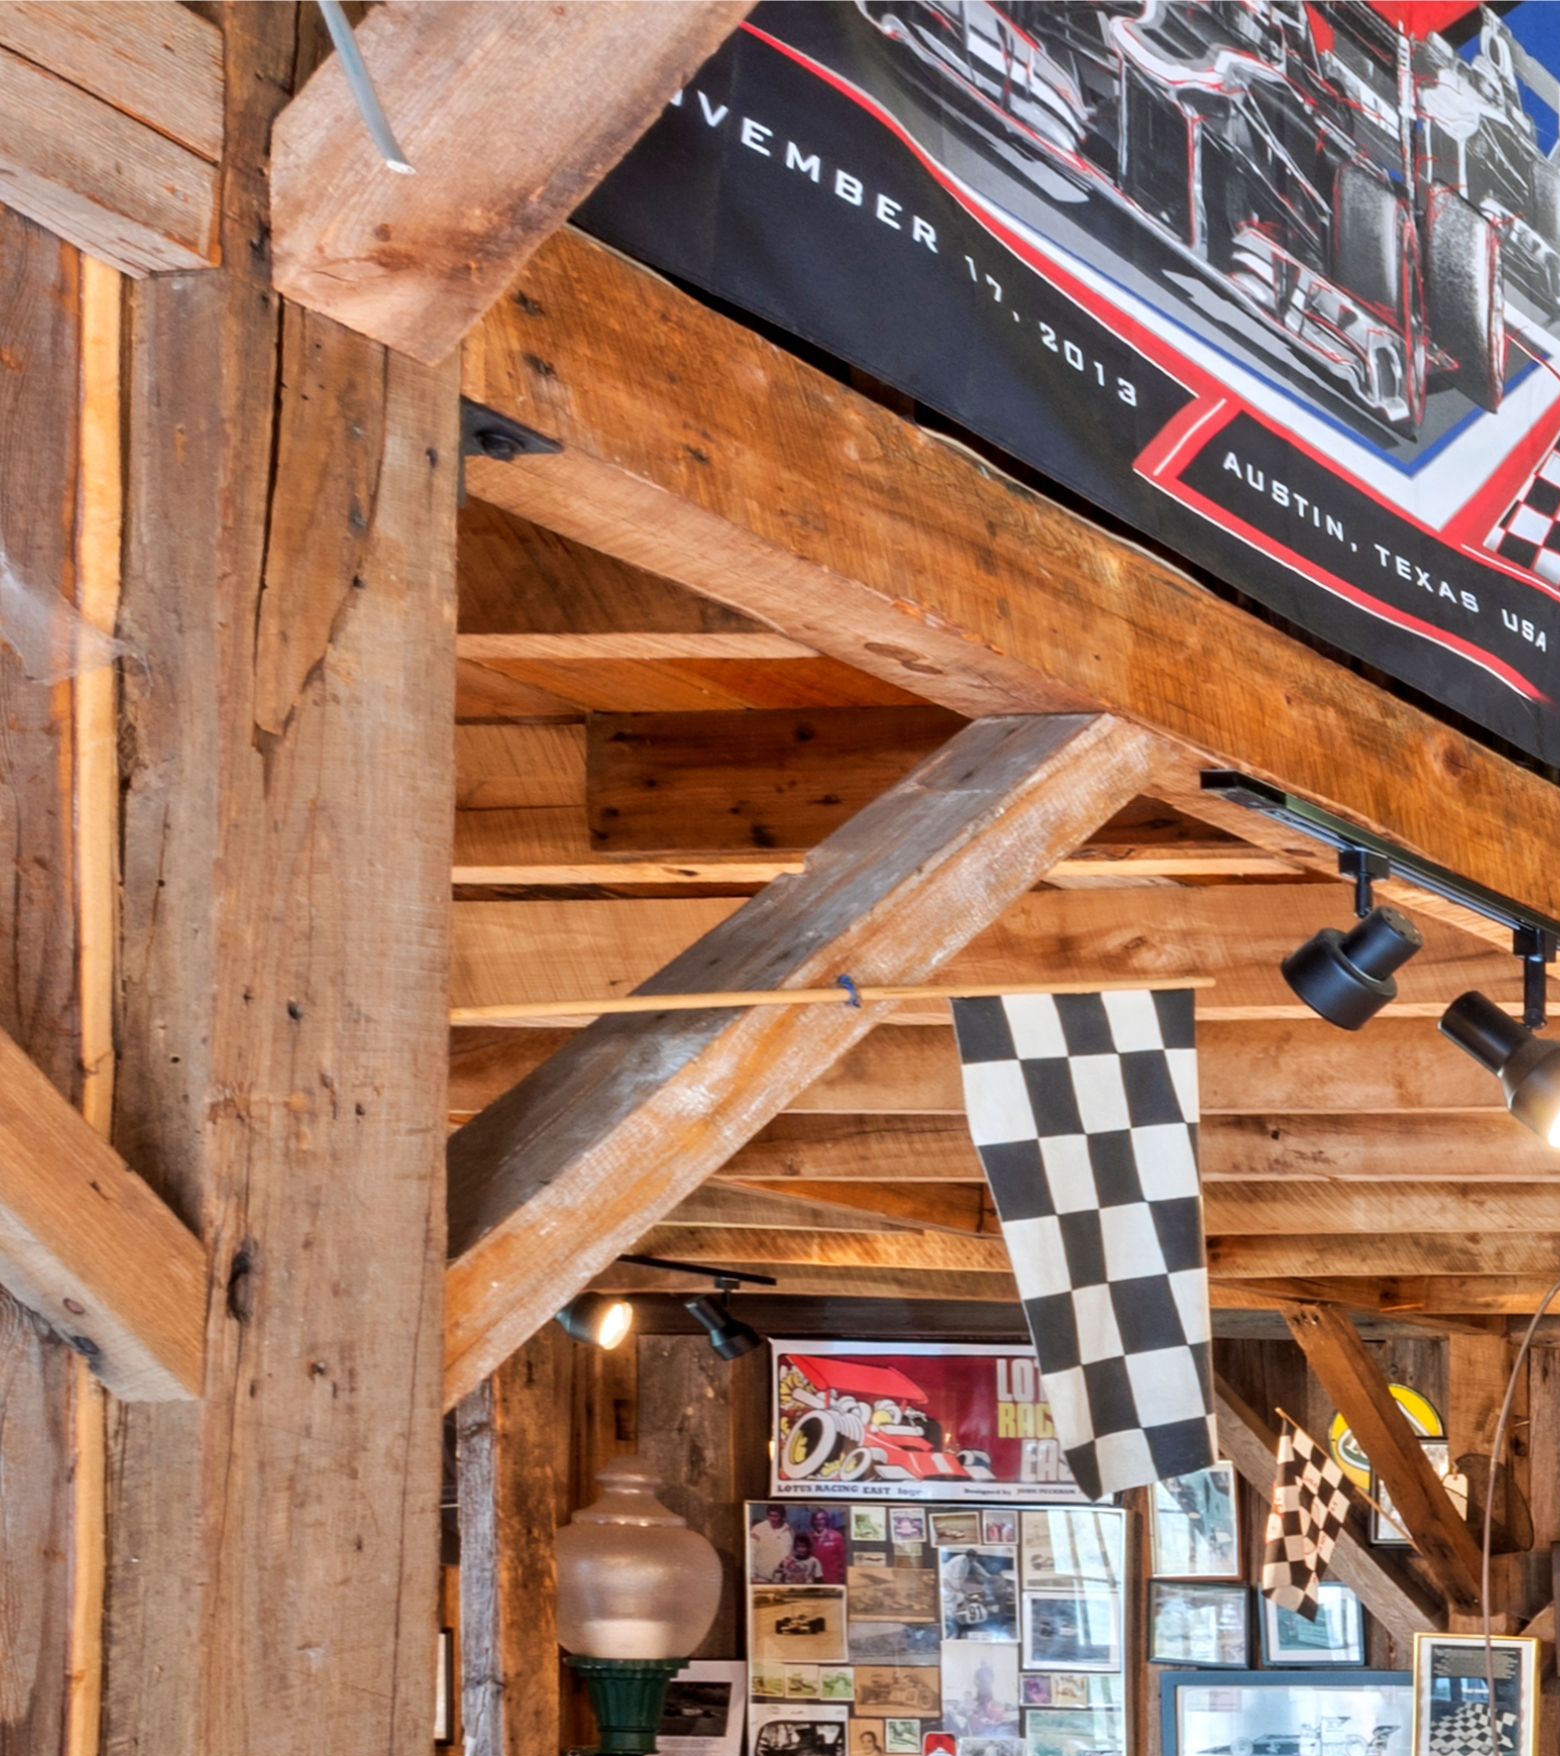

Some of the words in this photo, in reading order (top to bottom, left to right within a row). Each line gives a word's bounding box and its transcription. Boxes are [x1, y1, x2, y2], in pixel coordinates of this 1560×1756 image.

[668, 88, 939, 254] VEMBER
[1039, 321, 1137, 407] 2013
[1222, 451, 1358, 552] AUSTIN,
[1374, 543, 1480, 613] TEXAS
[1502, 608, 1547, 652] USA
[777, 1484, 812, 1493] LOTUS
[814, 1484, 859, 1493] RACING
[863, 1486, 891, 1495] EAST
